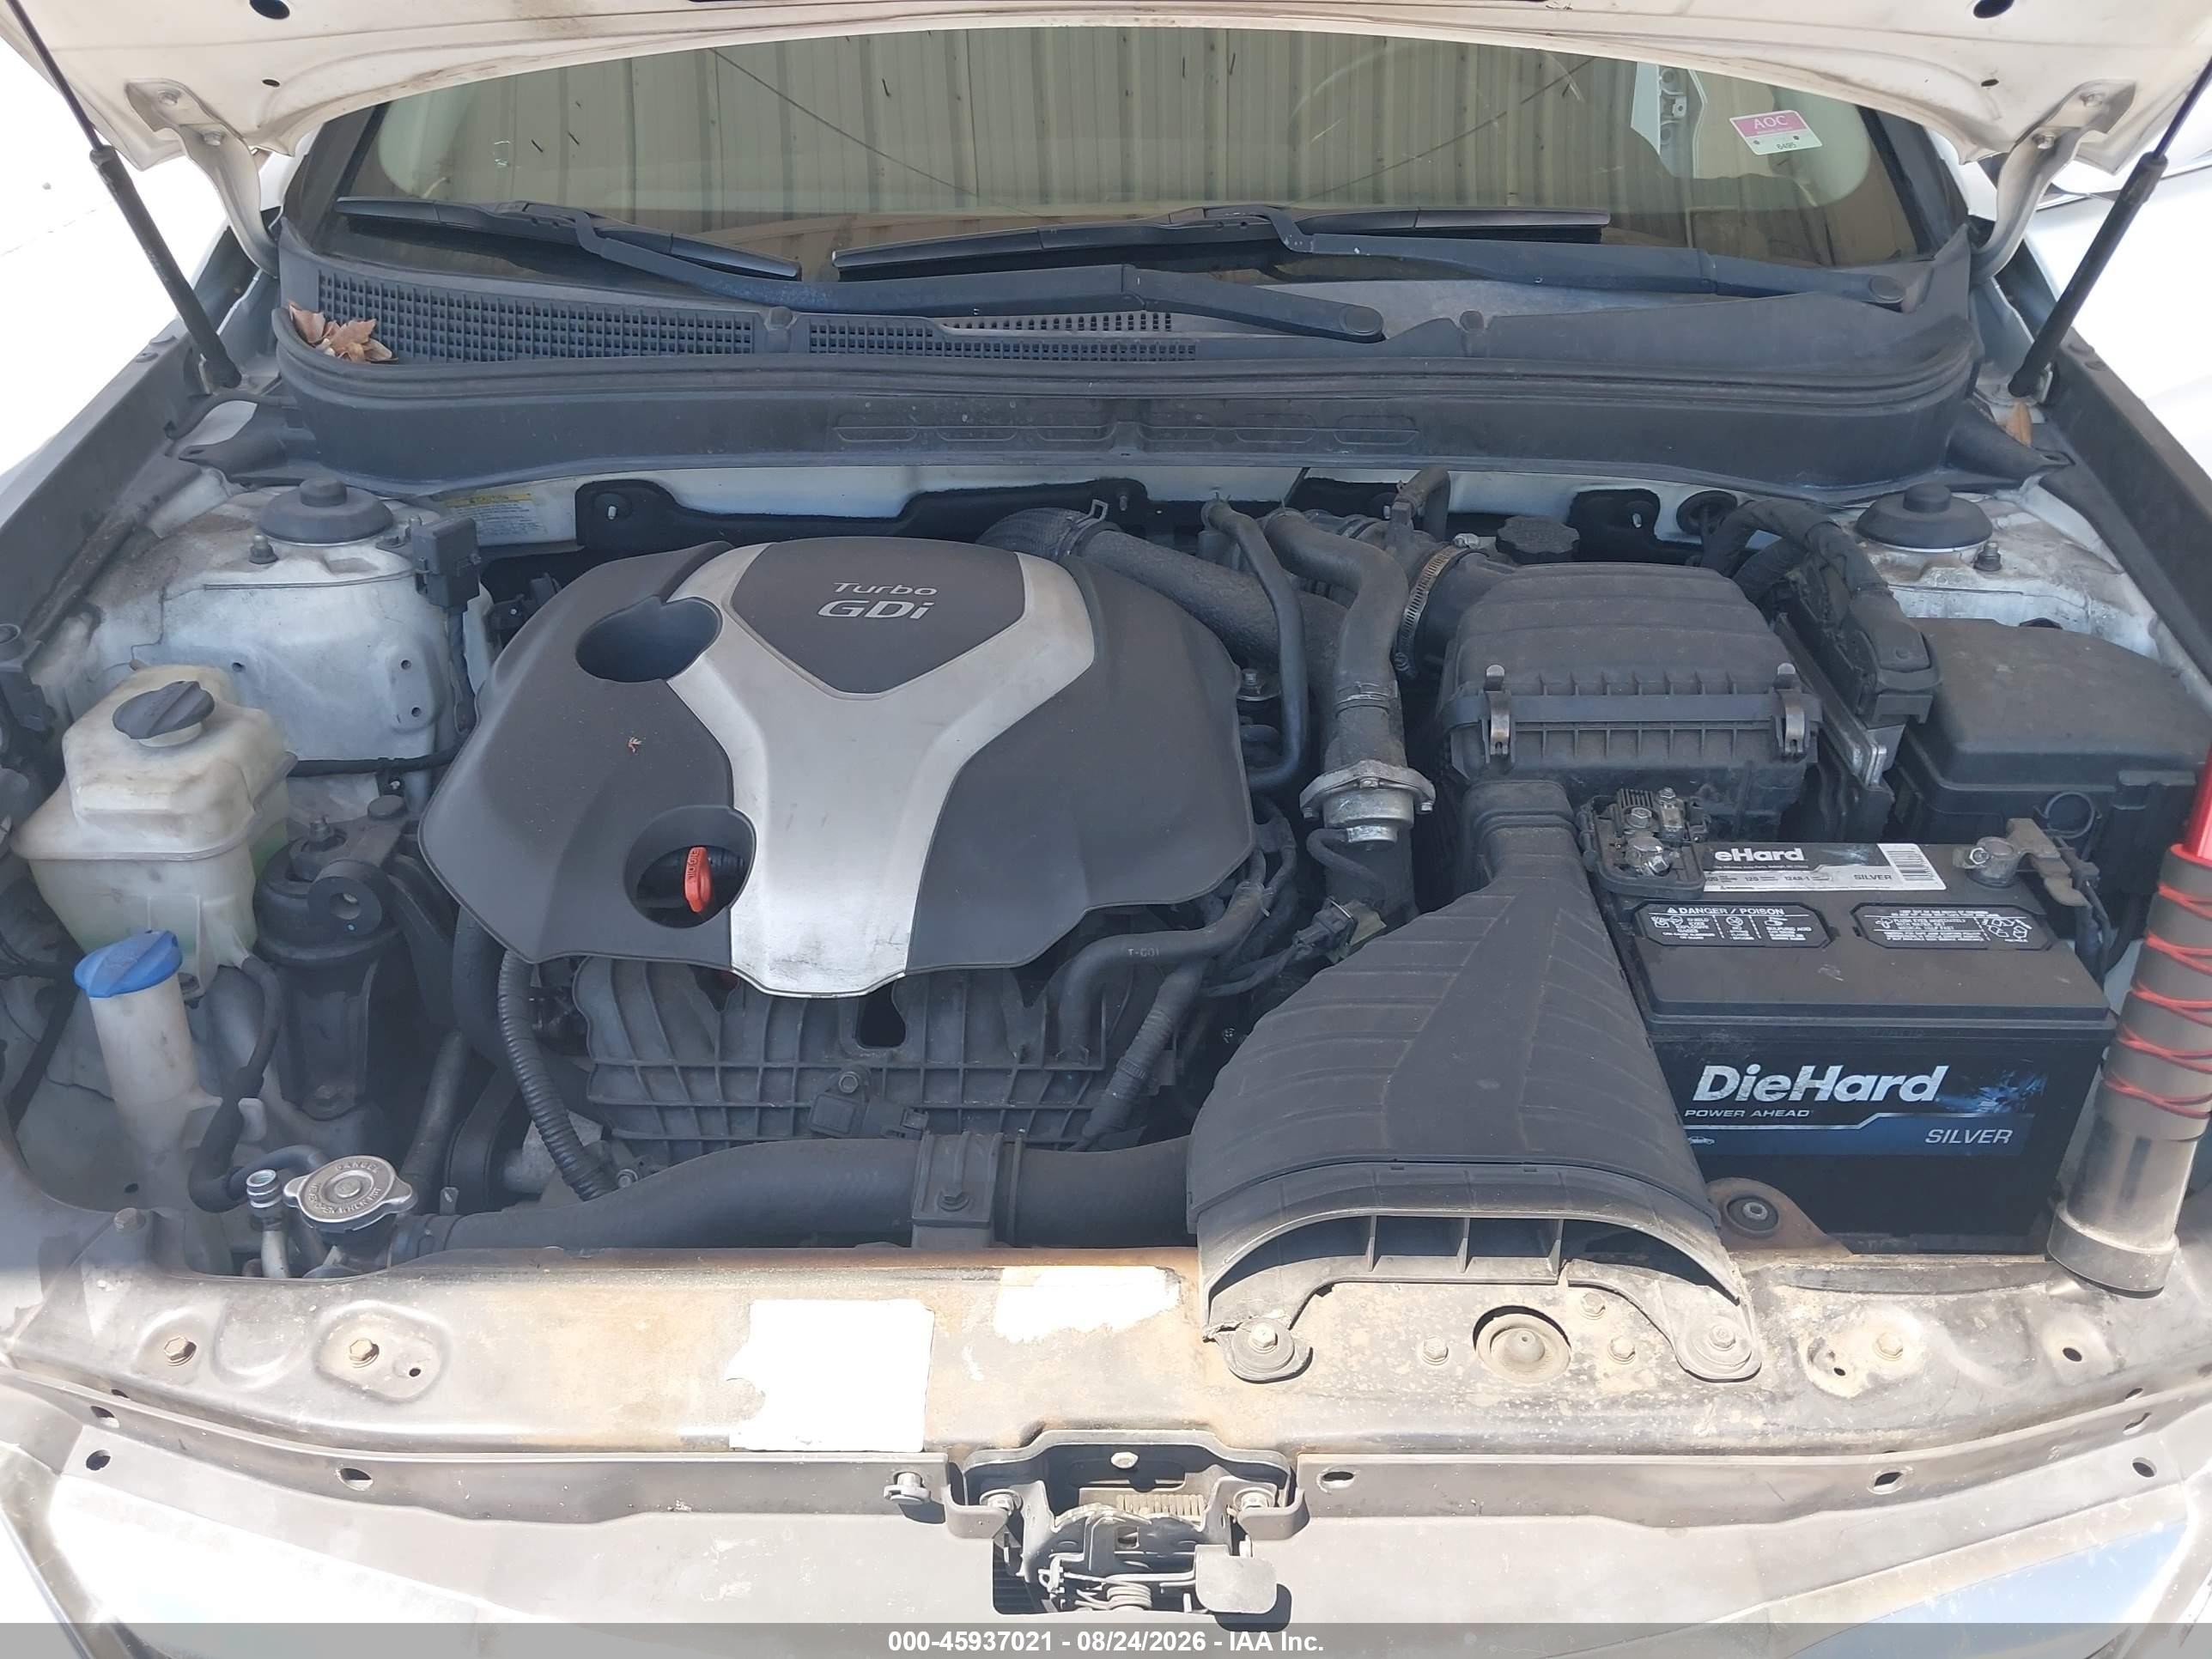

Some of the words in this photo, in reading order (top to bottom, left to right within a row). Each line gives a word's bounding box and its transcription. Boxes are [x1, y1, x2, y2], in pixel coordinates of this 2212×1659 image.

[1753, 115, 1789, 130] AOC
[833, 581, 939, 597] Turbo
[817, 599, 936, 620] GDi
[1714, 848, 1805, 862] eHard
[1679, 907, 1729, 915] DANGER
[1740, 907, 1785, 915] POISON
[1692, 1063, 1949, 1103] DieHard
[1924, 1128, 2014, 1145] SILVER
